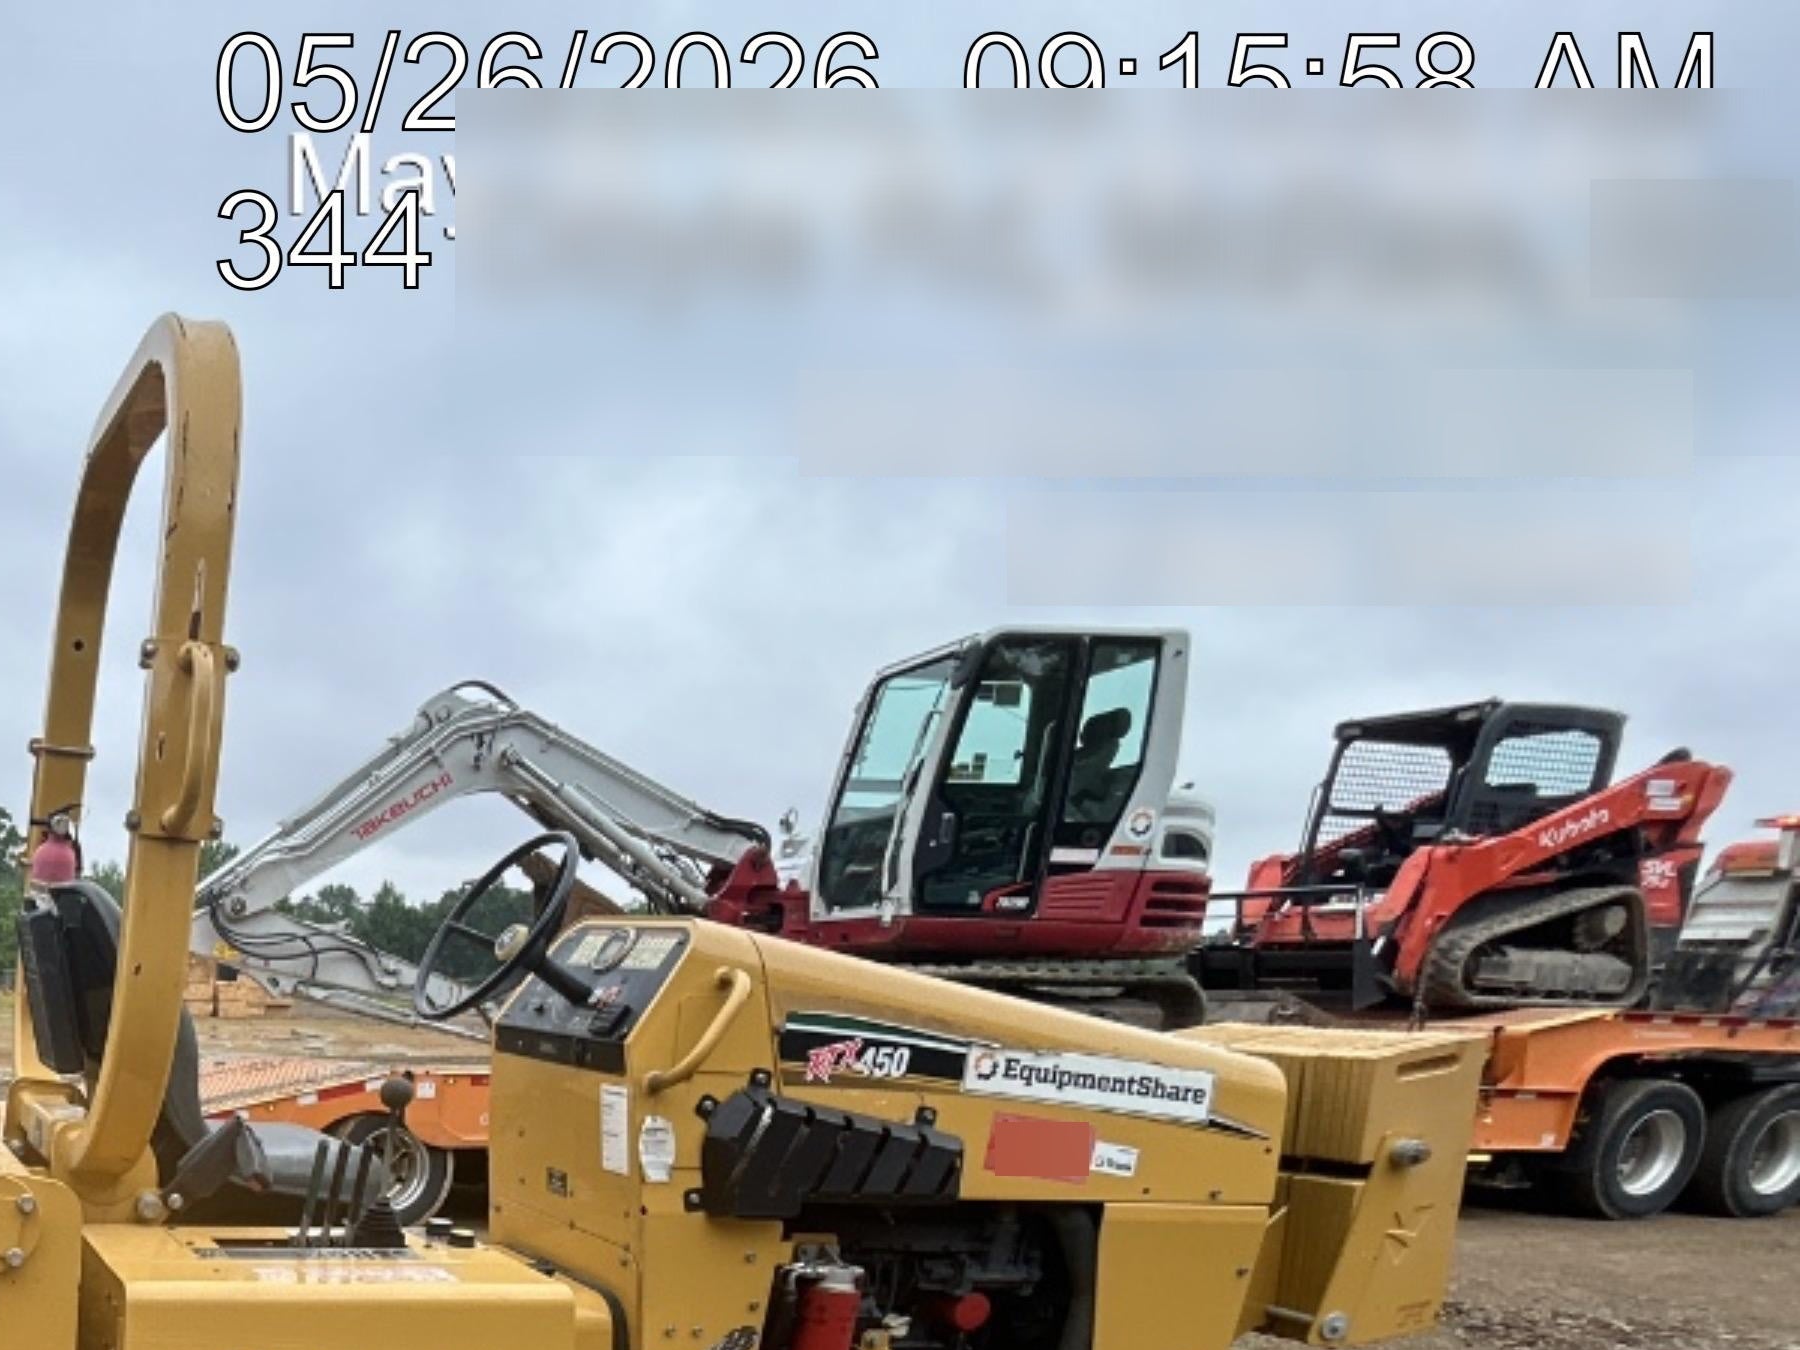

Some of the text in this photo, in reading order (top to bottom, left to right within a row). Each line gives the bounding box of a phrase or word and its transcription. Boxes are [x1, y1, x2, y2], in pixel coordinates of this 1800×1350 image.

[1538, 808, 1610, 847] Kubota
[853, 1045, 911, 1077] 450
[1001, 1057, 1208, 1105] EquipmentShare
